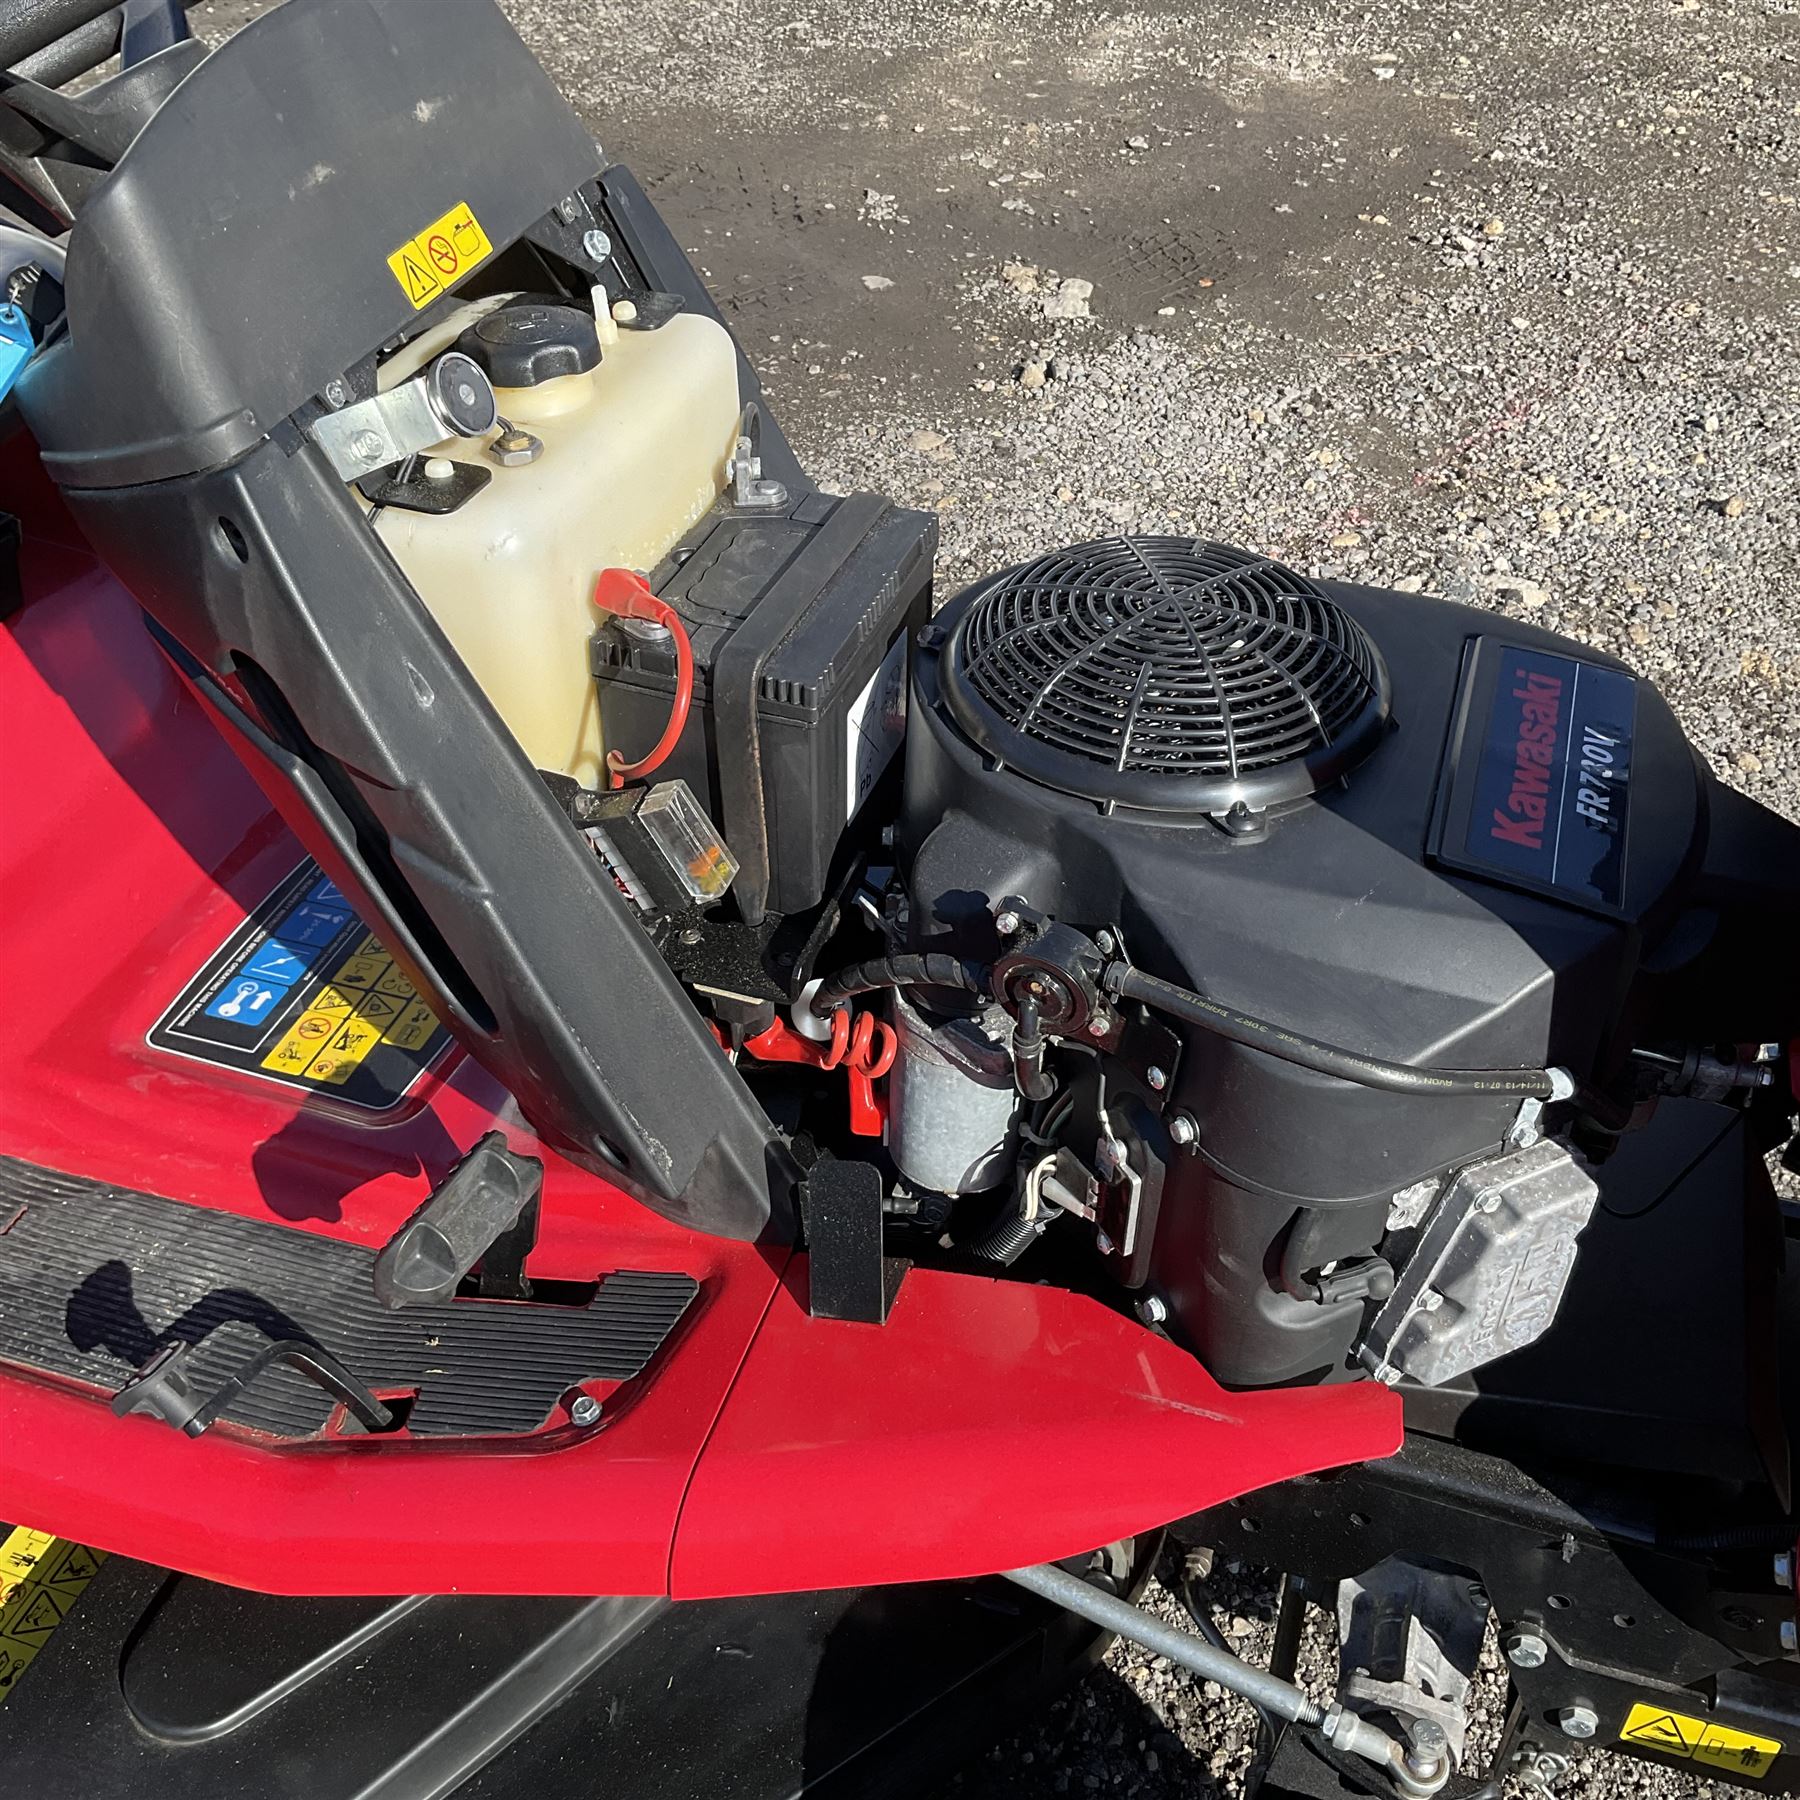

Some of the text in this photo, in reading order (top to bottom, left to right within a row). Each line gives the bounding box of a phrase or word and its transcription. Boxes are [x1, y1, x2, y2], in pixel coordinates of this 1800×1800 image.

[1491, 668, 1563, 849] Kawasaki
[235, 942, 256, 963] BEFORE
[210, 962, 239, 991] OPERATING
[199, 991, 213, 1003] THIS
[1176, 992, 1229, 1017] BARRIER
[177, 1003, 202, 1027] MACHINE
[1234, 1017, 1270, 1033] 30R7
[1276, 1032, 1303, 1046] SAE
[1424, 1077, 1453, 1087] AVON
[1506, 1081, 1546, 1089] 11/14/13
